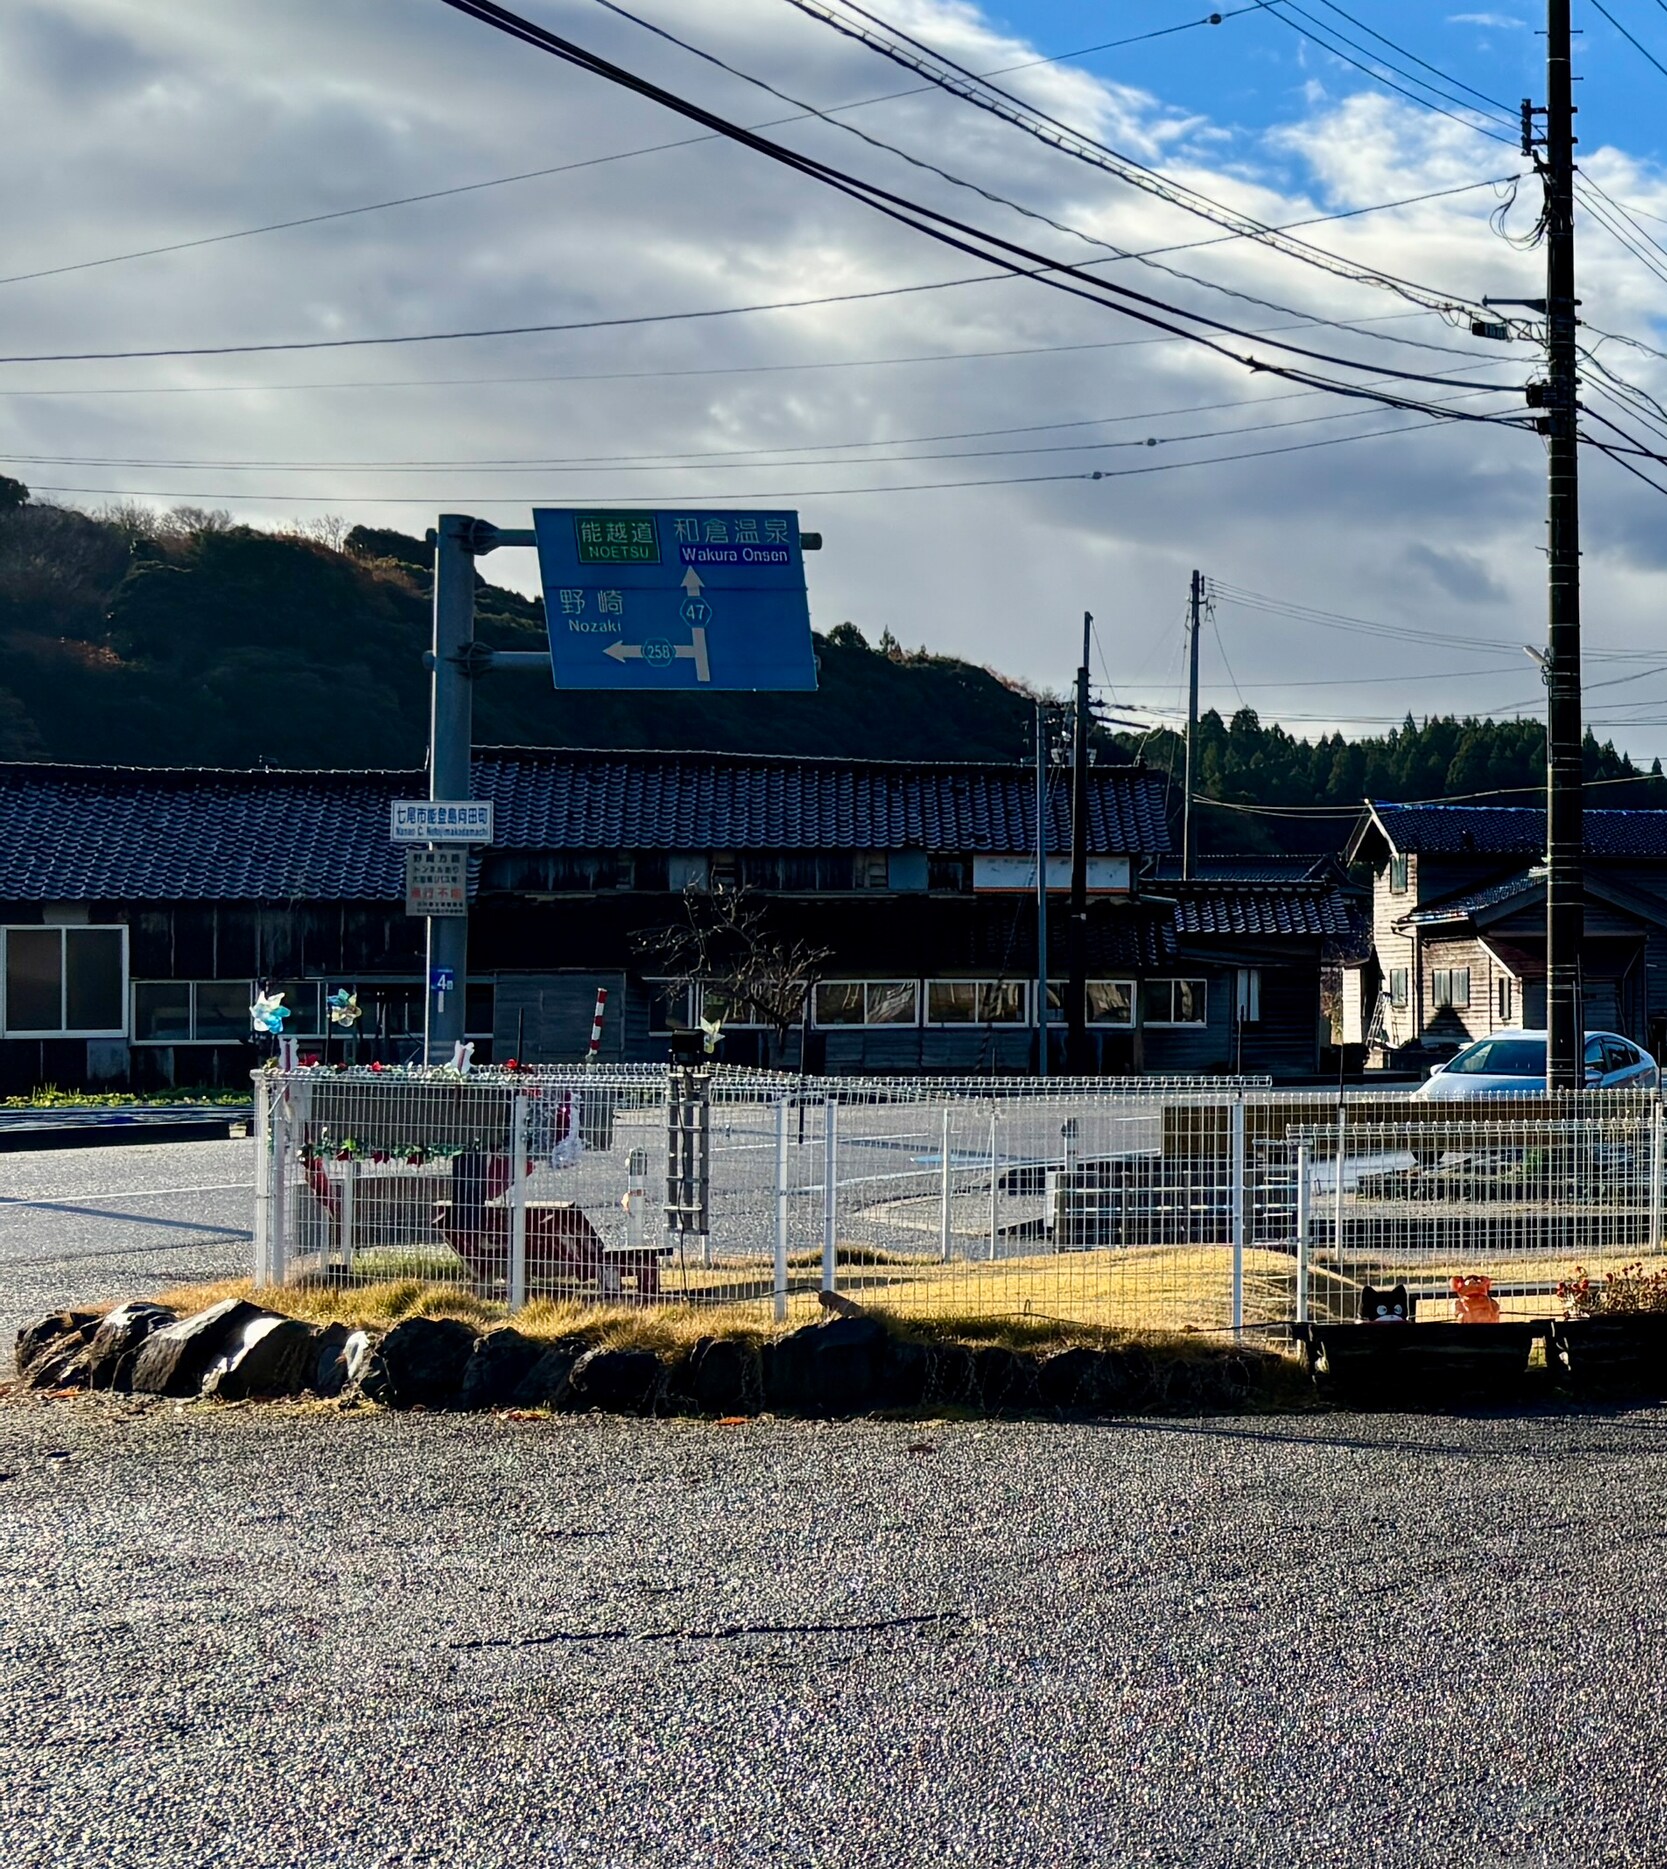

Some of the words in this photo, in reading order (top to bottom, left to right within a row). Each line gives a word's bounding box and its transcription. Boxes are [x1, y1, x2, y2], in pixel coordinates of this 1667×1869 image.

[581, 521, 653, 543] 能越道
[674, 518, 790, 543] 和倉温泉
[589, 545, 649, 559] NOETSU
[682, 547, 738, 562] Wakura
[742, 547, 788, 562] Onsen
[559, 589, 624, 615] 野崎
[686, 604, 705, 620] 47
[568, 619, 622, 632] Nozaki
[646, 645, 671, 659] 258
